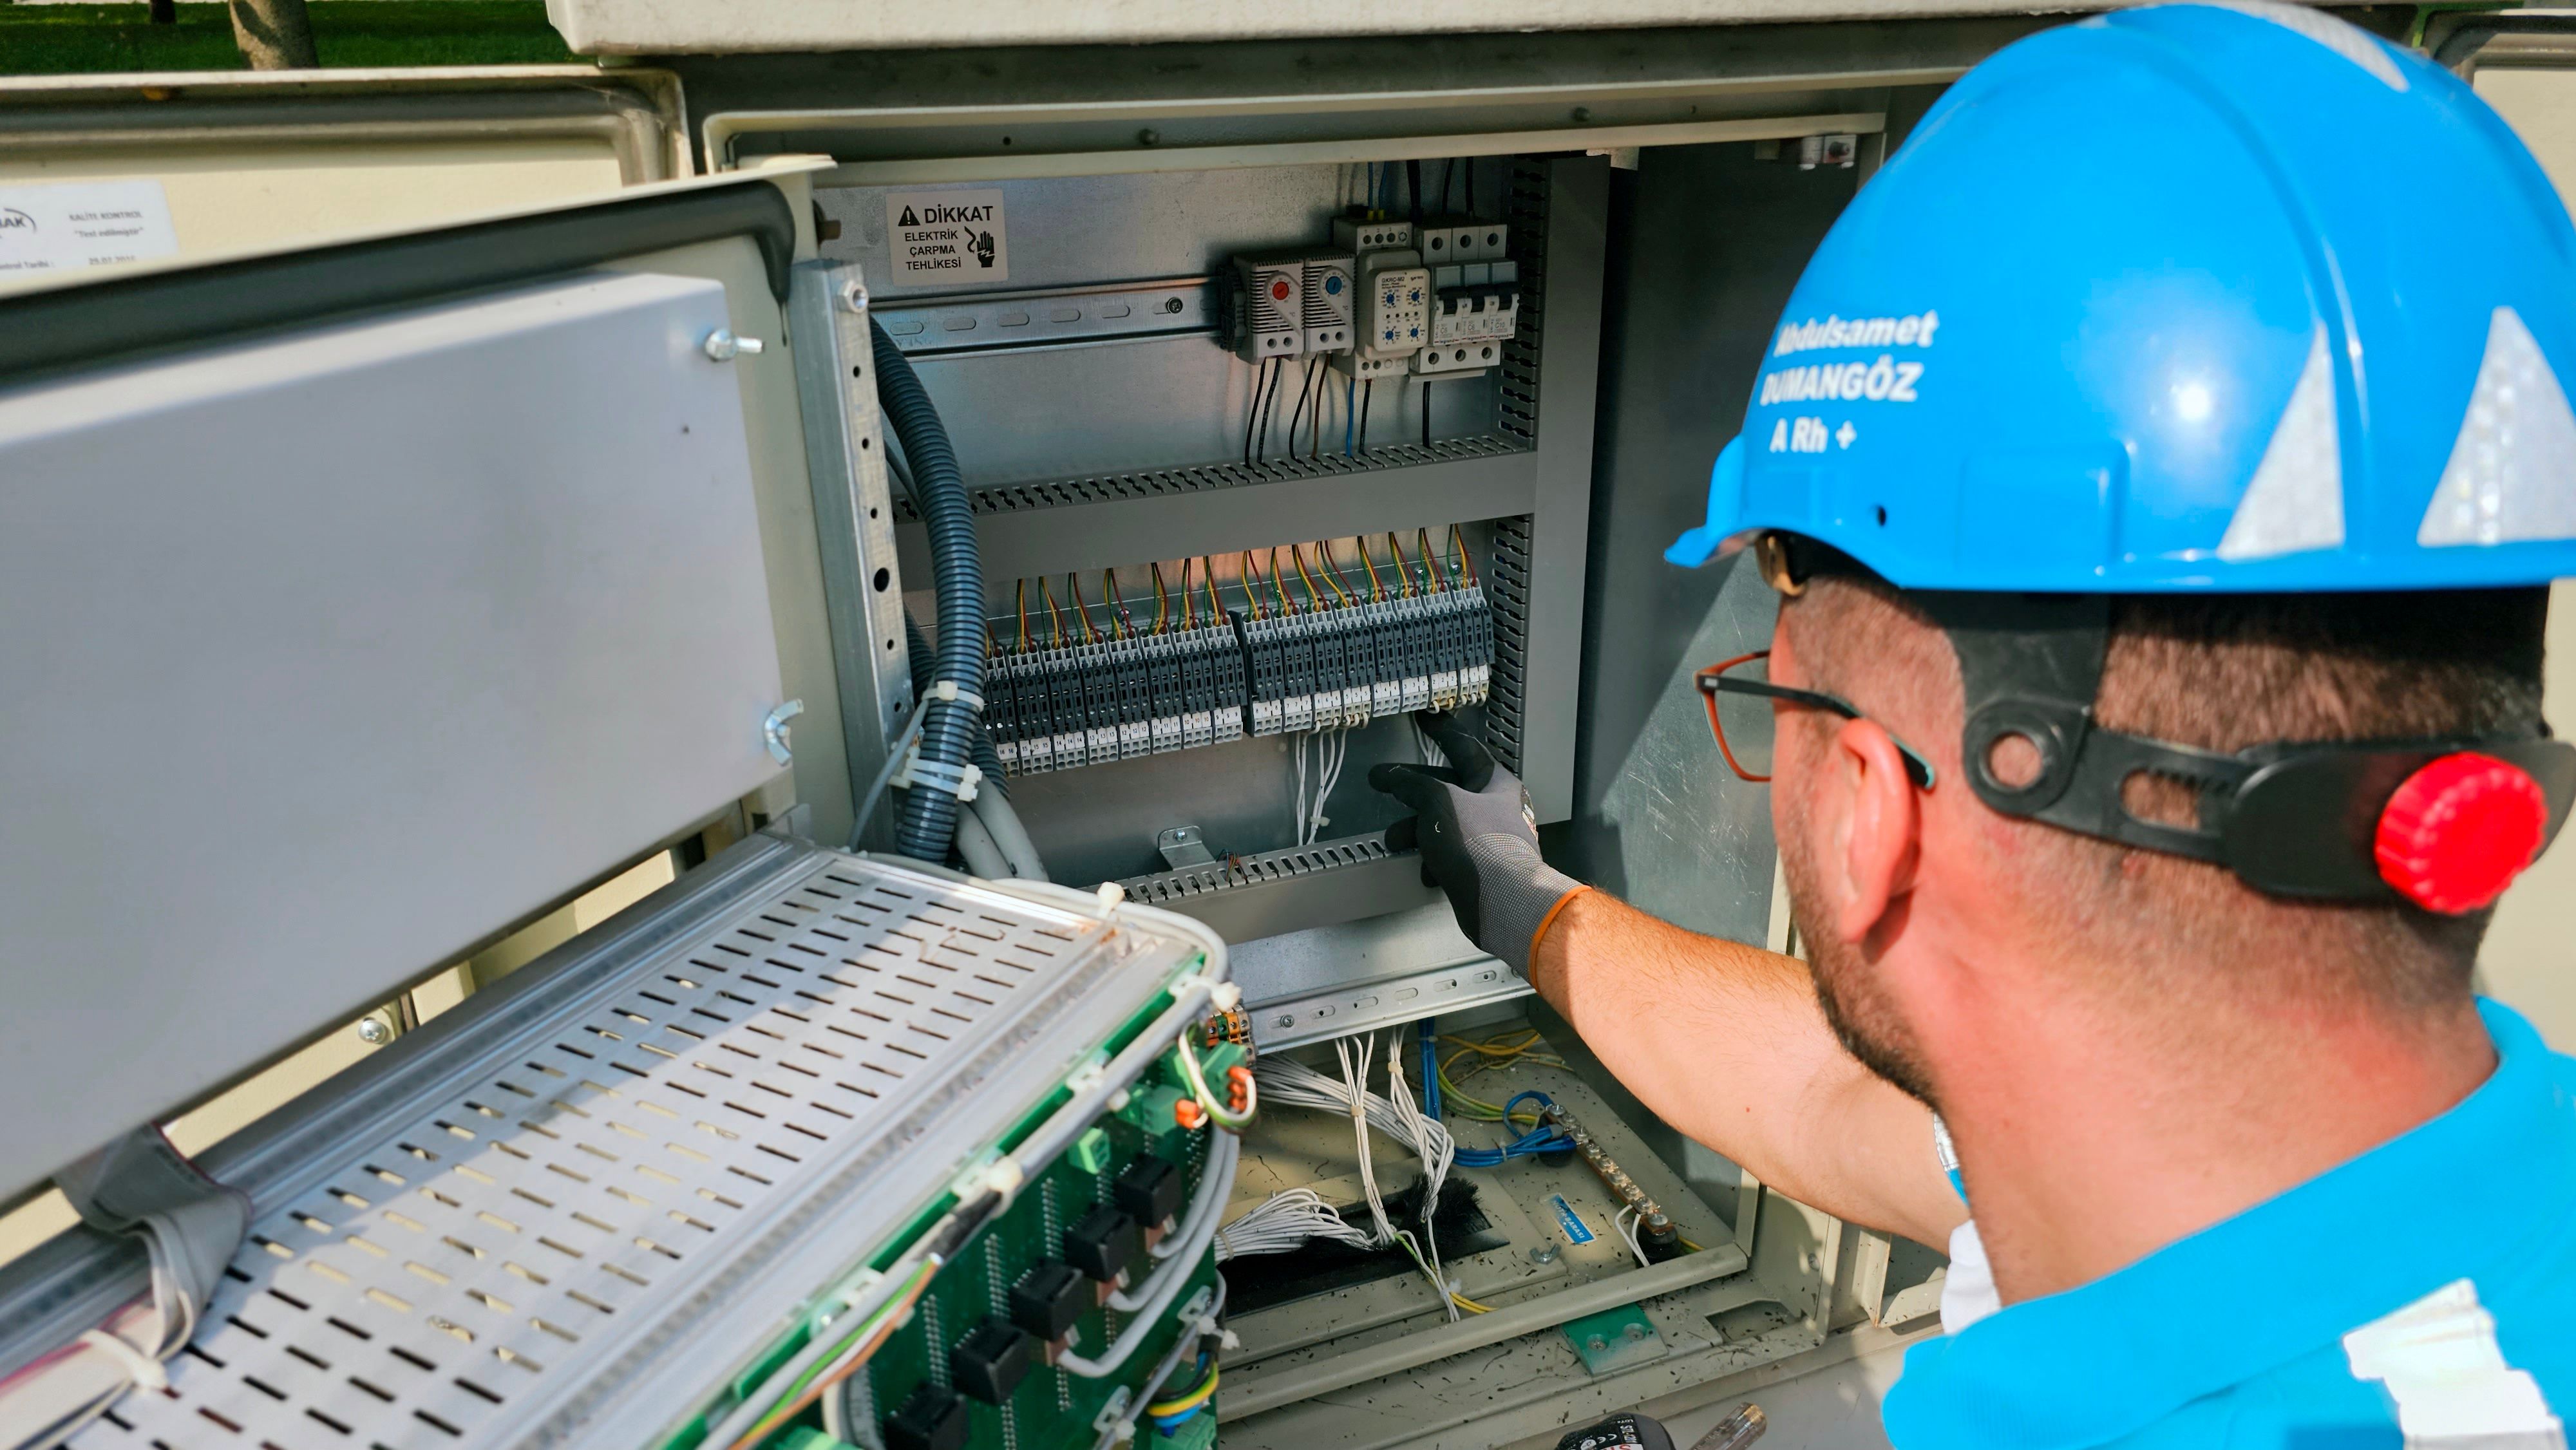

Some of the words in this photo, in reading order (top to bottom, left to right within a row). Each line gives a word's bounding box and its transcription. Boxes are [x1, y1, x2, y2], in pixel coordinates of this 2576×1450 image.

[100, 211, 142, 220] KONTROL
[924, 204, 993, 223] DİKKAT
[905, 229, 958, 241] ELEKTRİK
[909, 245, 956, 258] ÇARPMA
[905, 257, 961, 270] TEHLİKESİ
[1773, 309, 1939, 358] Abdulsamet
[1770, 418, 1787, 453] A
[1791, 416, 1828, 453] Rh
[1564, 1216, 1585, 1239] BARASI
